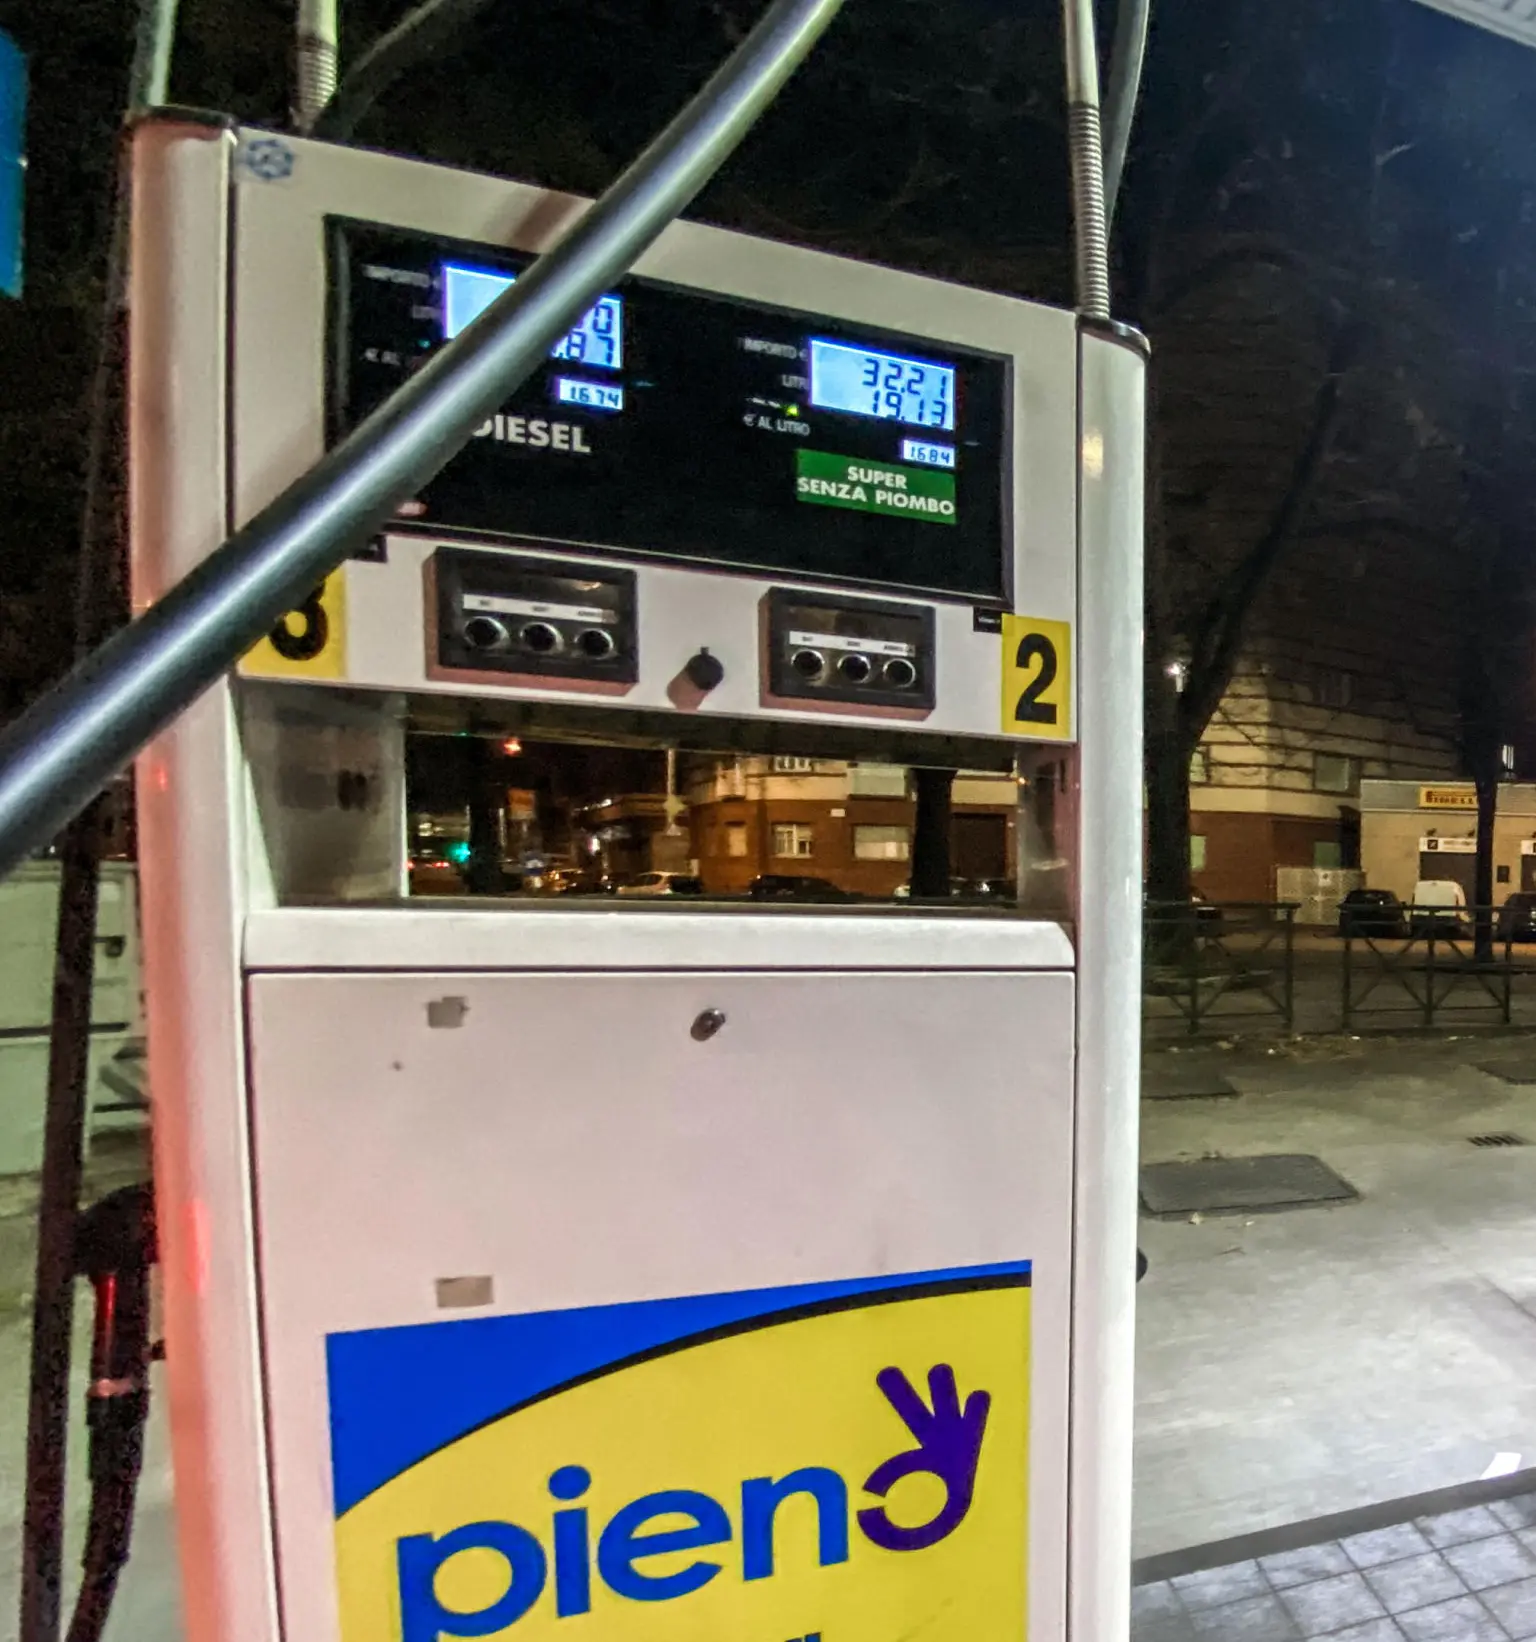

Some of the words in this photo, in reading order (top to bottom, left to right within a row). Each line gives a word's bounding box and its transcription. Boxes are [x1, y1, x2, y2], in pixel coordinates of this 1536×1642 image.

[862, 357, 948, 399] 32.21
[873, 390, 947, 427] 19.13
[797, 477, 867, 502] SENZA
[875, 489, 955, 516] PIOMBO
[847, 466, 907, 489] SUPER
[1014, 632, 1058, 724] 2
